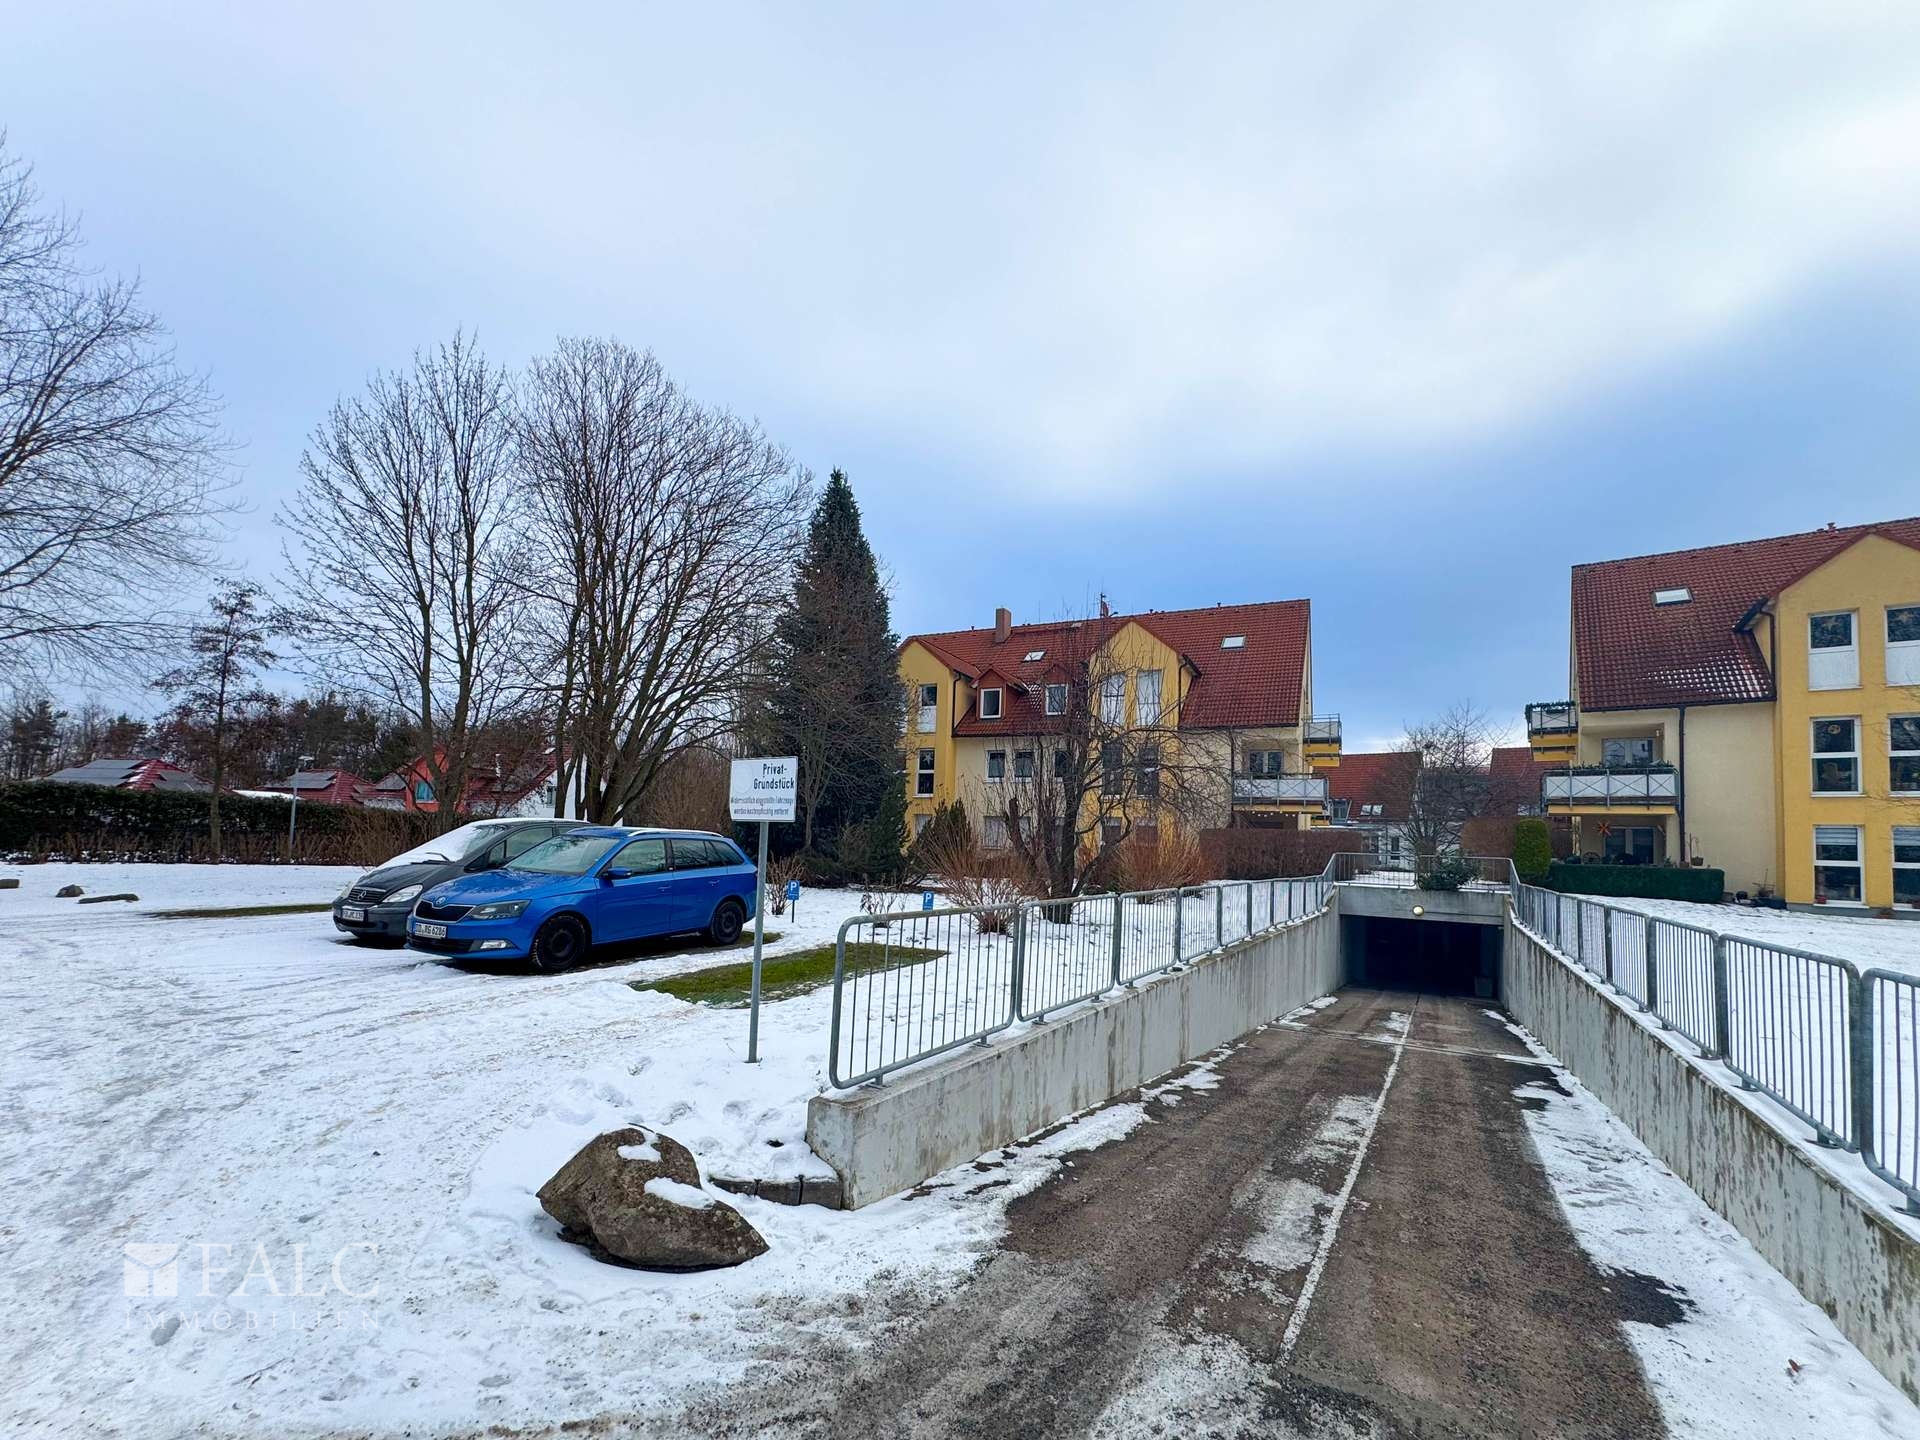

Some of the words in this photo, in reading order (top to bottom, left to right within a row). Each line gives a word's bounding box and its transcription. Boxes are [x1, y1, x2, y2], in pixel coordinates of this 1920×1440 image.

[763, 763, 787, 775] Privat-
[753, 776, 795, 790] Grundstück
[791, 882, 797, 891] P
[925, 893, 932, 902] P
